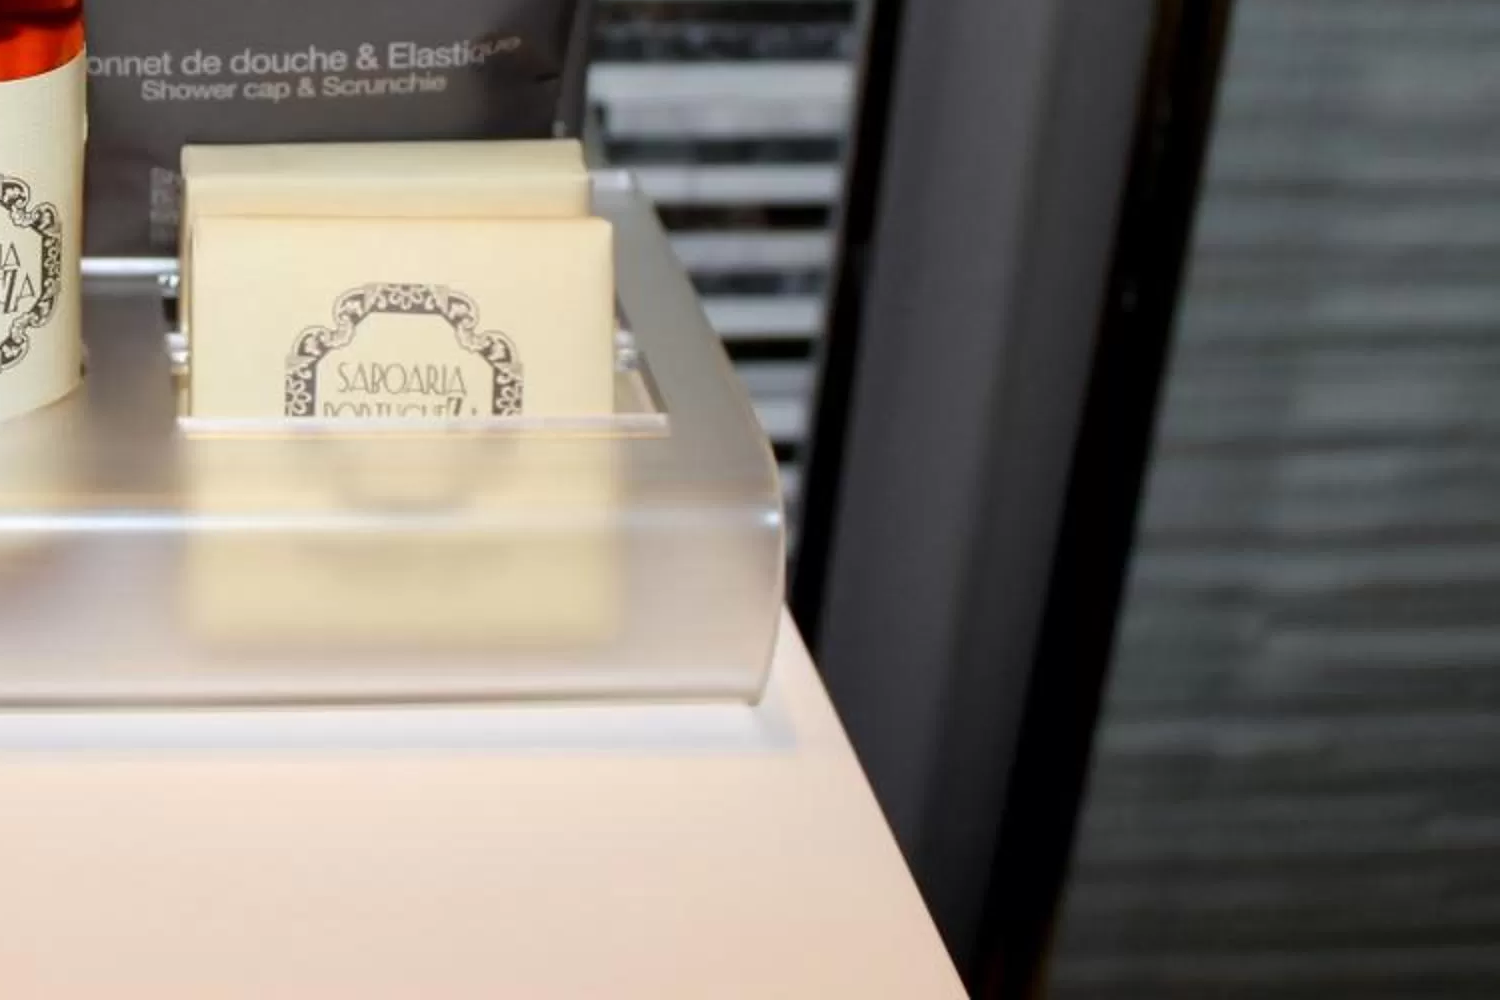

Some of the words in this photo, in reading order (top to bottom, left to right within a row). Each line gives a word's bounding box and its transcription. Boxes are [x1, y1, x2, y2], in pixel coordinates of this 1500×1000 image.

[87, 50, 173, 77] onnet
[180, 48, 222, 75] de
[229, 43, 348, 75] douche
[356, 41, 380, 71] &
[141, 78, 236, 101] Shower
[243, 80, 290, 104] cap
[298, 75, 316, 98] &
[321, 70, 448, 97] Scrunchie
